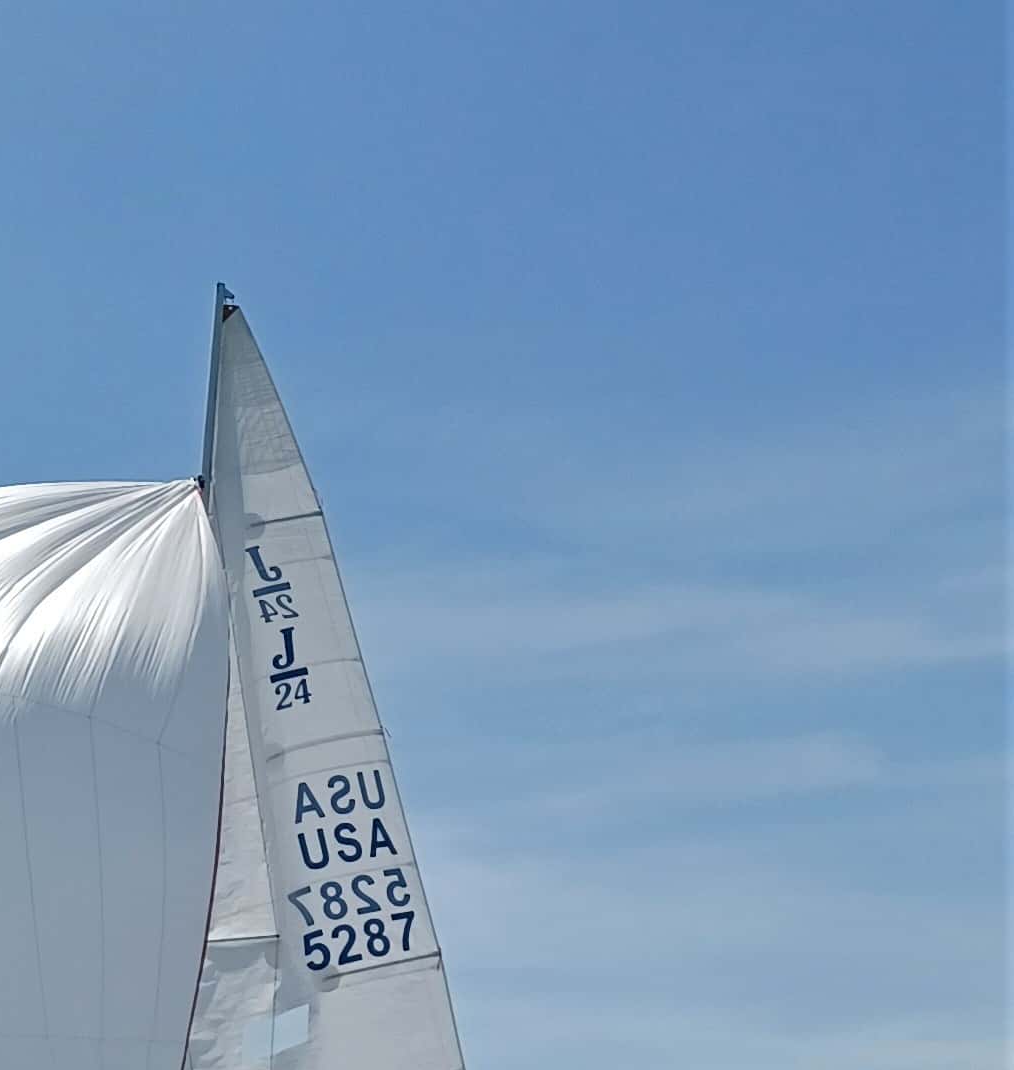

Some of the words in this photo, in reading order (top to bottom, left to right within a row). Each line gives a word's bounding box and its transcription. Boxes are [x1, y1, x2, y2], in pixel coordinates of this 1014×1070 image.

[272, 626, 295, 670] J
[274, 678, 312, 711] 24
[297, 817, 398, 870] USA
[302, 910, 415, 971] 5287
